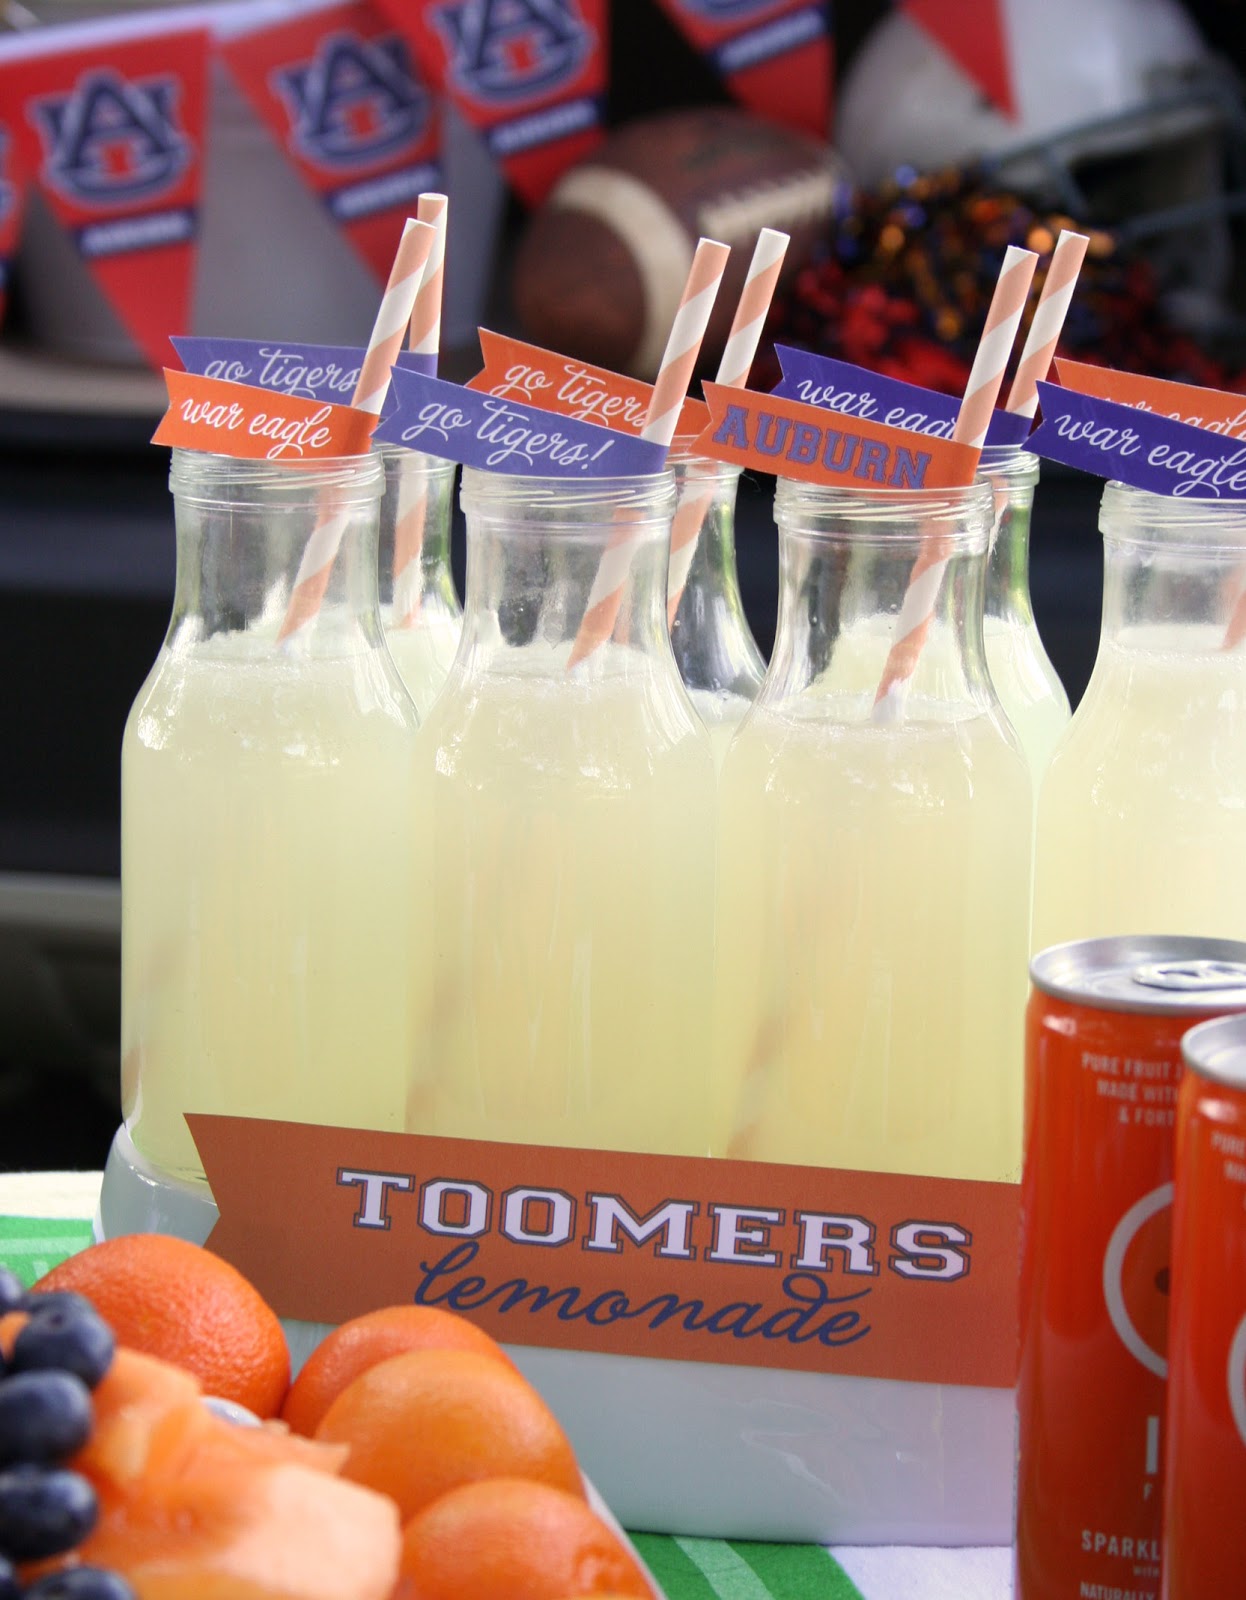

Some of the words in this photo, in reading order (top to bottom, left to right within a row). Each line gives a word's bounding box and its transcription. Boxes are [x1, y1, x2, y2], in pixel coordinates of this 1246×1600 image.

[489, 364, 553, 401] go
[797, 379, 878, 419] war
[180, 398, 244, 430] war
[249, 405, 333, 460] eagle
[401, 402, 472, 442] go
[475, 400, 615, 471] tigers!
[712, 404, 932, 490] AUBURN
[1054, 414, 1142, 457] war
[336, 1166, 973, 1283] TOOMERS
[413, 1241, 872, 1347] lemonade
